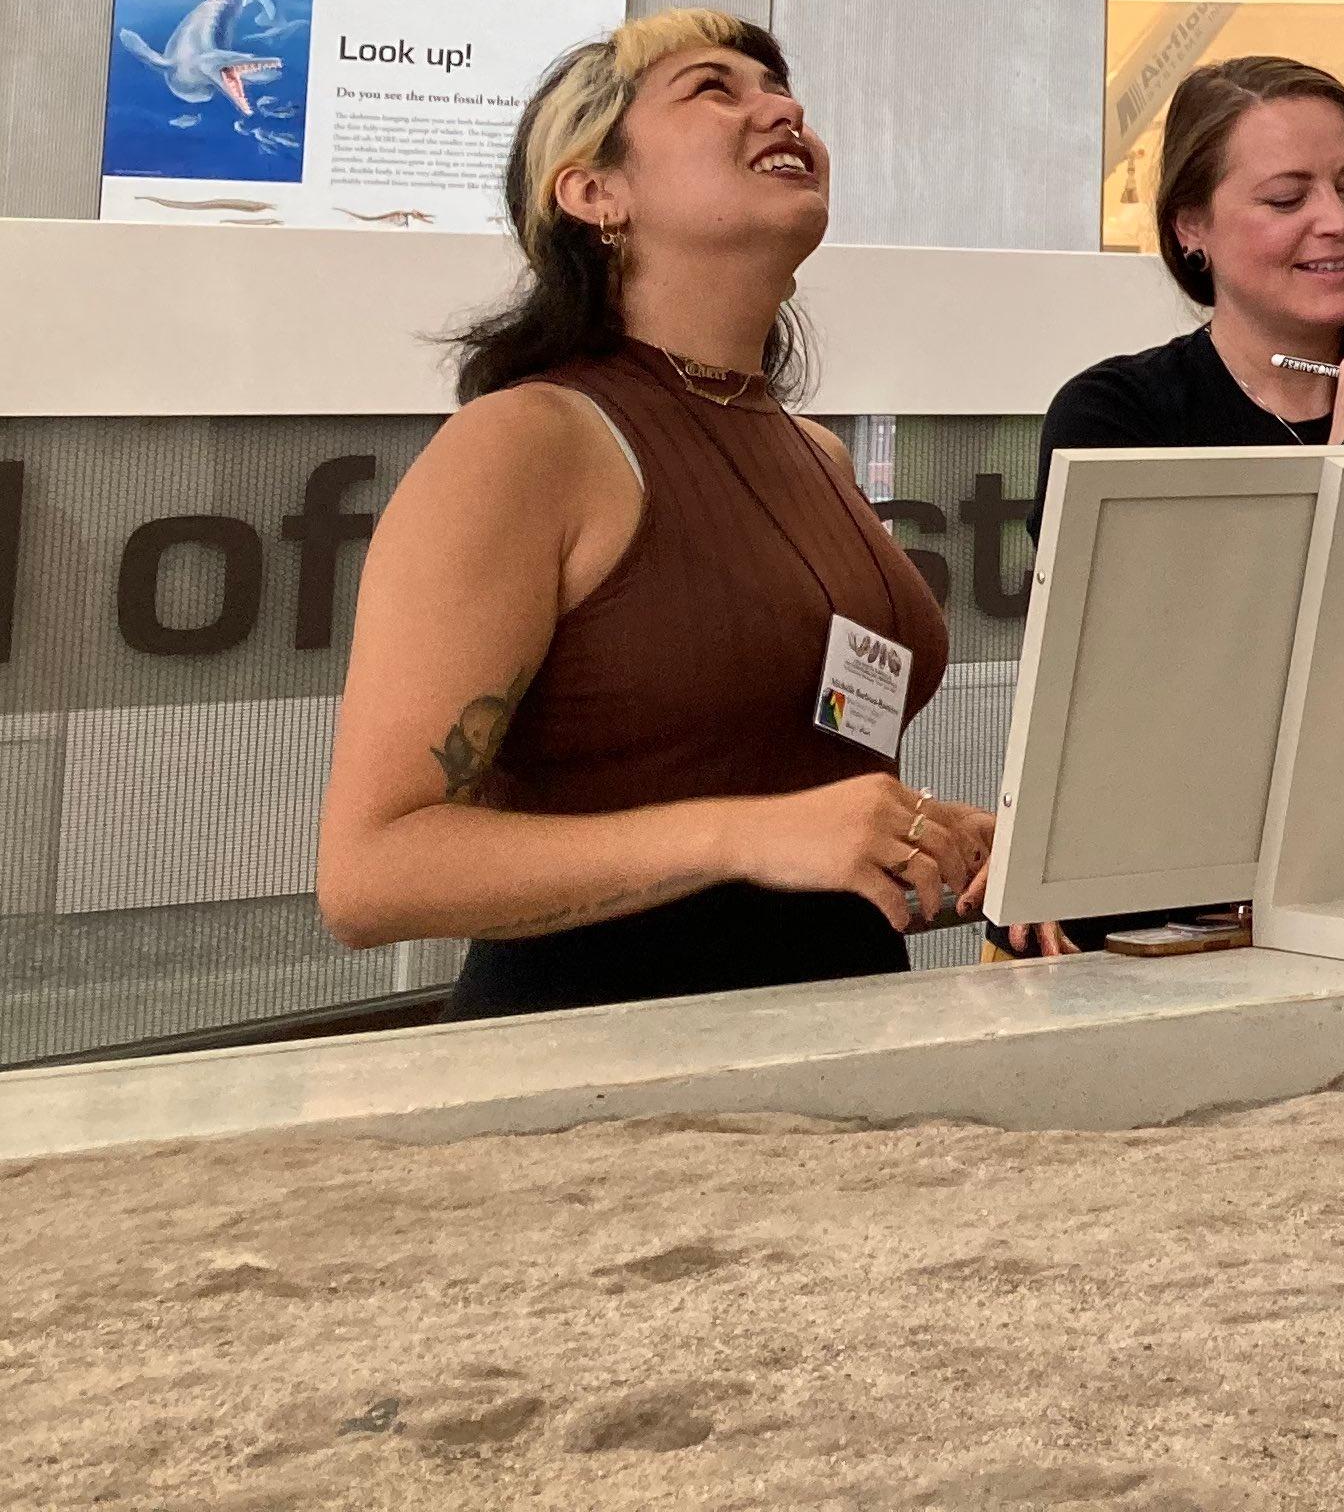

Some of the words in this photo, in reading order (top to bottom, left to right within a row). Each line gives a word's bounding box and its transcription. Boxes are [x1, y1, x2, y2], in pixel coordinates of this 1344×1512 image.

[339, 35, 415, 65] Look
[427, 43, 472, 73] up!
[336, 86, 356, 99] Do
[358, 90, 381, 102] you
[384, 92, 402, 101] see
[406, 90, 425, 102] the
[428, 94, 449, 103] two
[453, 92, 483, 105] fossil
[487, 94, 521, 107] whale
[117, 454, 378, 656] of
